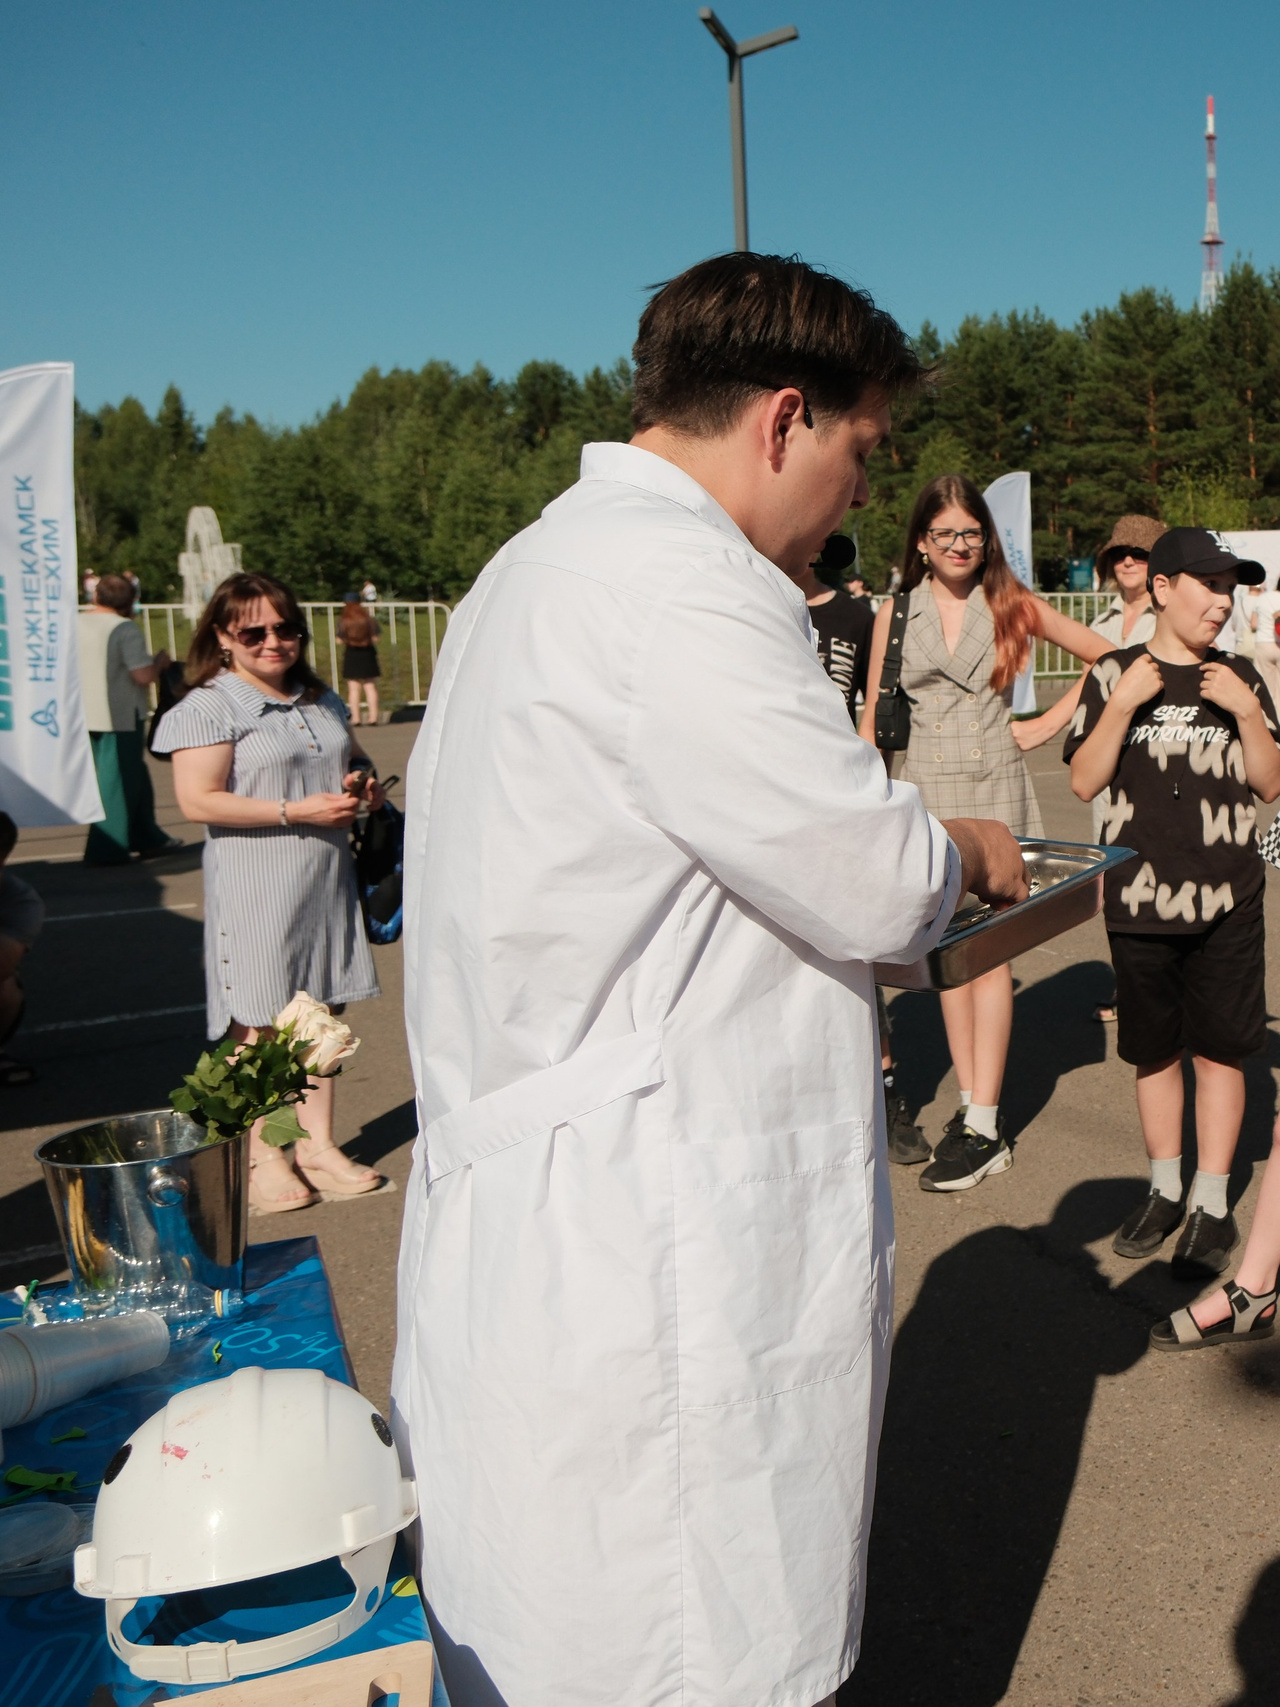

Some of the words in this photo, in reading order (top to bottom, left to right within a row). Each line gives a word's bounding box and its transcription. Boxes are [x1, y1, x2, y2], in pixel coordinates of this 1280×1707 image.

[14, 474, 45, 682] НИЖНЕКАМСК
[828, 637, 857, 702] OME
[1153, 705, 1200, 722] SEIZE
